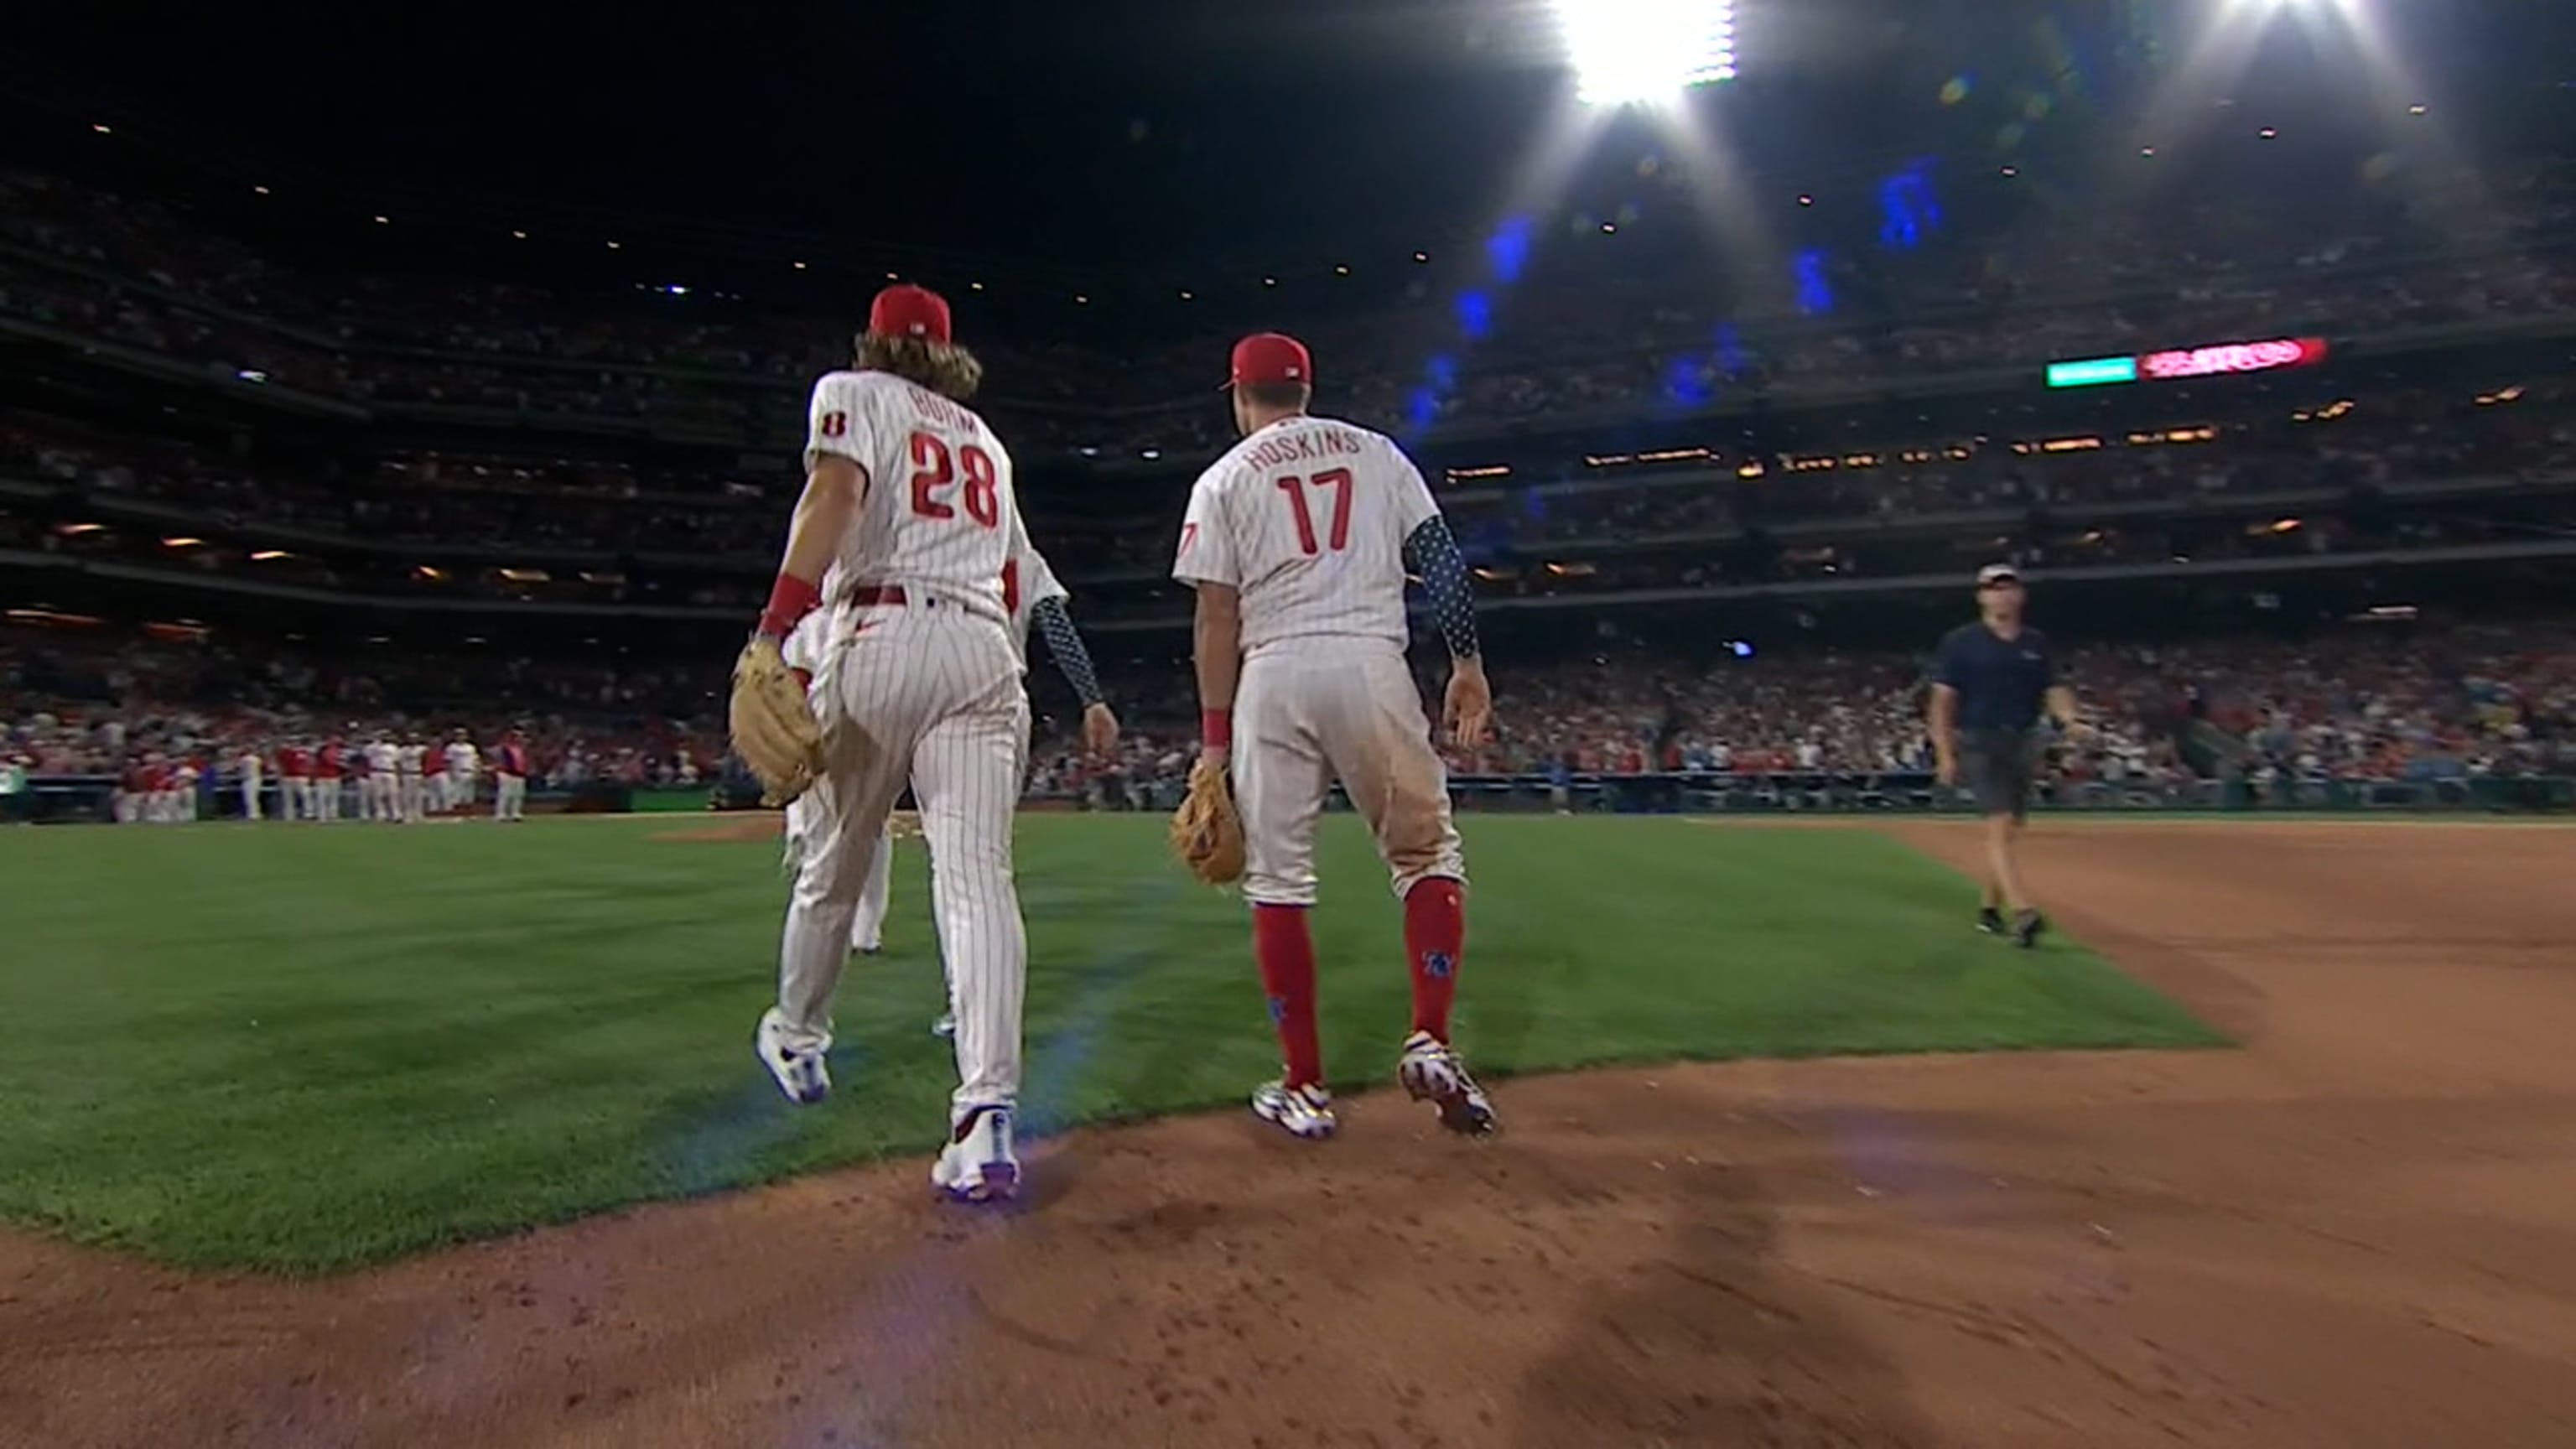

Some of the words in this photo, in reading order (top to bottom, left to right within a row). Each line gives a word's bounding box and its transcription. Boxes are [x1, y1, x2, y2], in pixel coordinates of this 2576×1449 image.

[910, 430, 998, 529] 28
[1243, 428, 1361, 473] HOSKINS
[1276, 466, 1353, 555] 17
